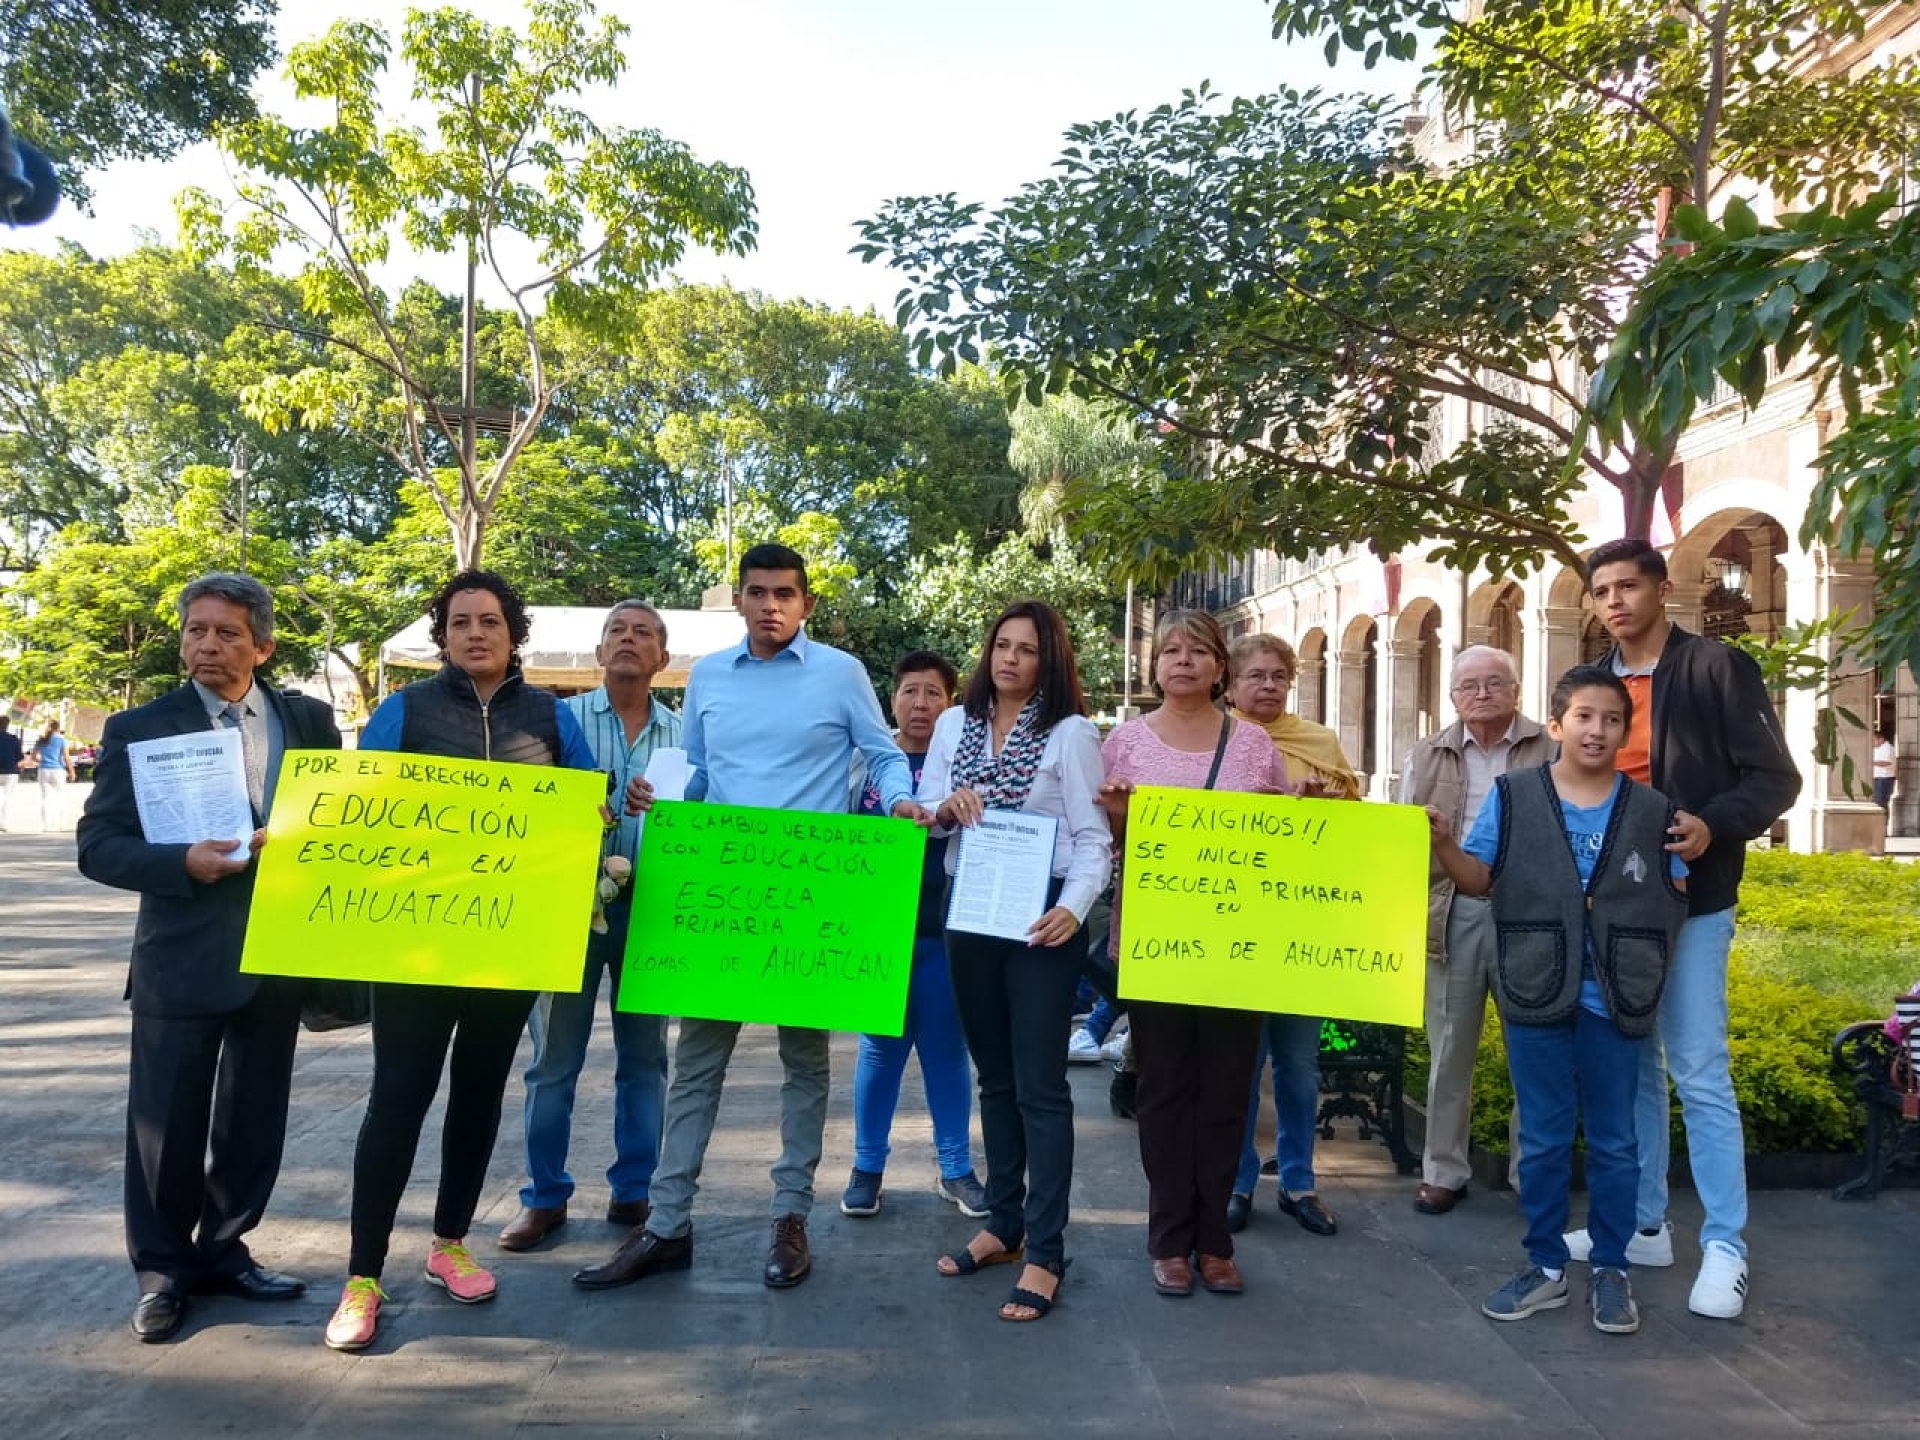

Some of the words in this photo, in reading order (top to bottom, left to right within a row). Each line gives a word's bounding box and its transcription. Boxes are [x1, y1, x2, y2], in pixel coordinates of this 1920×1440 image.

[294, 756, 340, 777] POR
[358, 759, 383, 775] EL
[396, 762, 490, 787] DERECHO
[498, 776, 512, 793] A
[533, 779, 558, 794] LA
[308, 792, 528, 839] EDUCACIÓN
[653, 809, 676, 827] EL
[692, 811, 768, 835] CAMBIO
[783, 824, 898, 846] VERDADERO
[298, 841, 431, 868] ESCUELA
[471, 854, 517, 873] EN
[661, 842, 700, 854] CON
[720, 841, 877, 876] EDUCACIÓN
[1135, 841, 1168, 860] SE
[1197, 847, 1268, 868] INICIE
[674, 882, 816, 911] ESCUELA
[1138, 872, 1237, 896] ESCUELA
[1260, 880, 1363, 904] PRIMARIA
[308, 884, 514, 930] AHUATLAN
[1216, 902, 1241, 914] EN
[673, 914, 784, 936] PRIMARIA
[818, 921, 849, 938] EN
[632, 955, 690, 973] LOMAS
[720, 955, 741, 973] DE
[761, 944, 893, 981] AHUATLAN
[1131, 937, 1205, 960] LOMAS
[1229, 941, 1258, 960] DE
[1284, 941, 1404, 973] AHUATLAN
